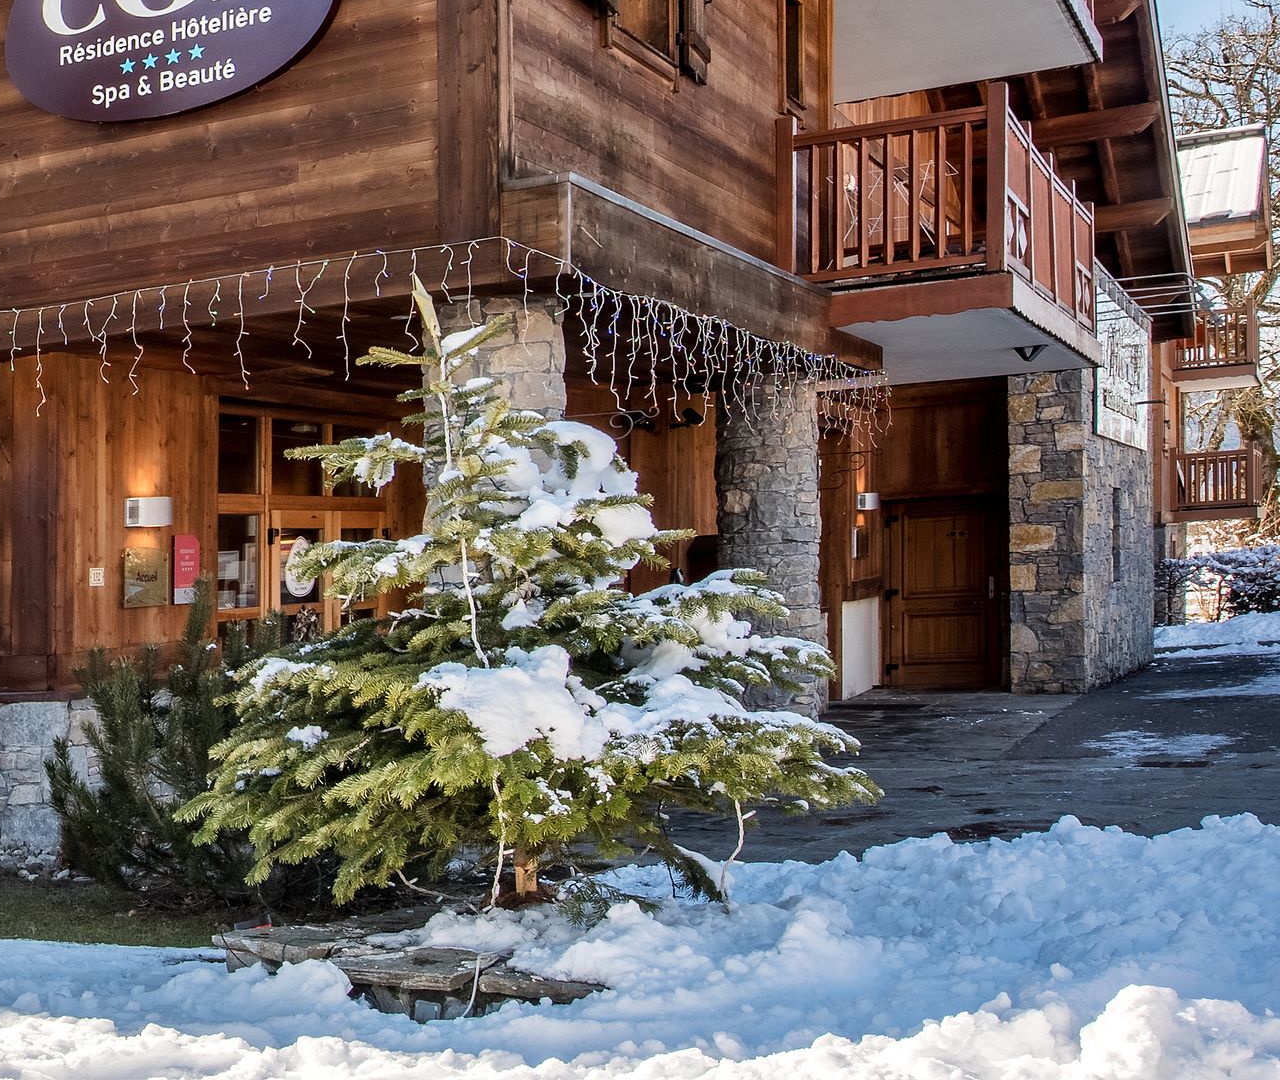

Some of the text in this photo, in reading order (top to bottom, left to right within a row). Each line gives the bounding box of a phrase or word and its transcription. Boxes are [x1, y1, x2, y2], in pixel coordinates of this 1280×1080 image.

[58, 5, 273, 67] Résidence Hôtelière
[91, 57, 237, 109] Spa & Beauté
[135, 570, 159, 583] Accueil
